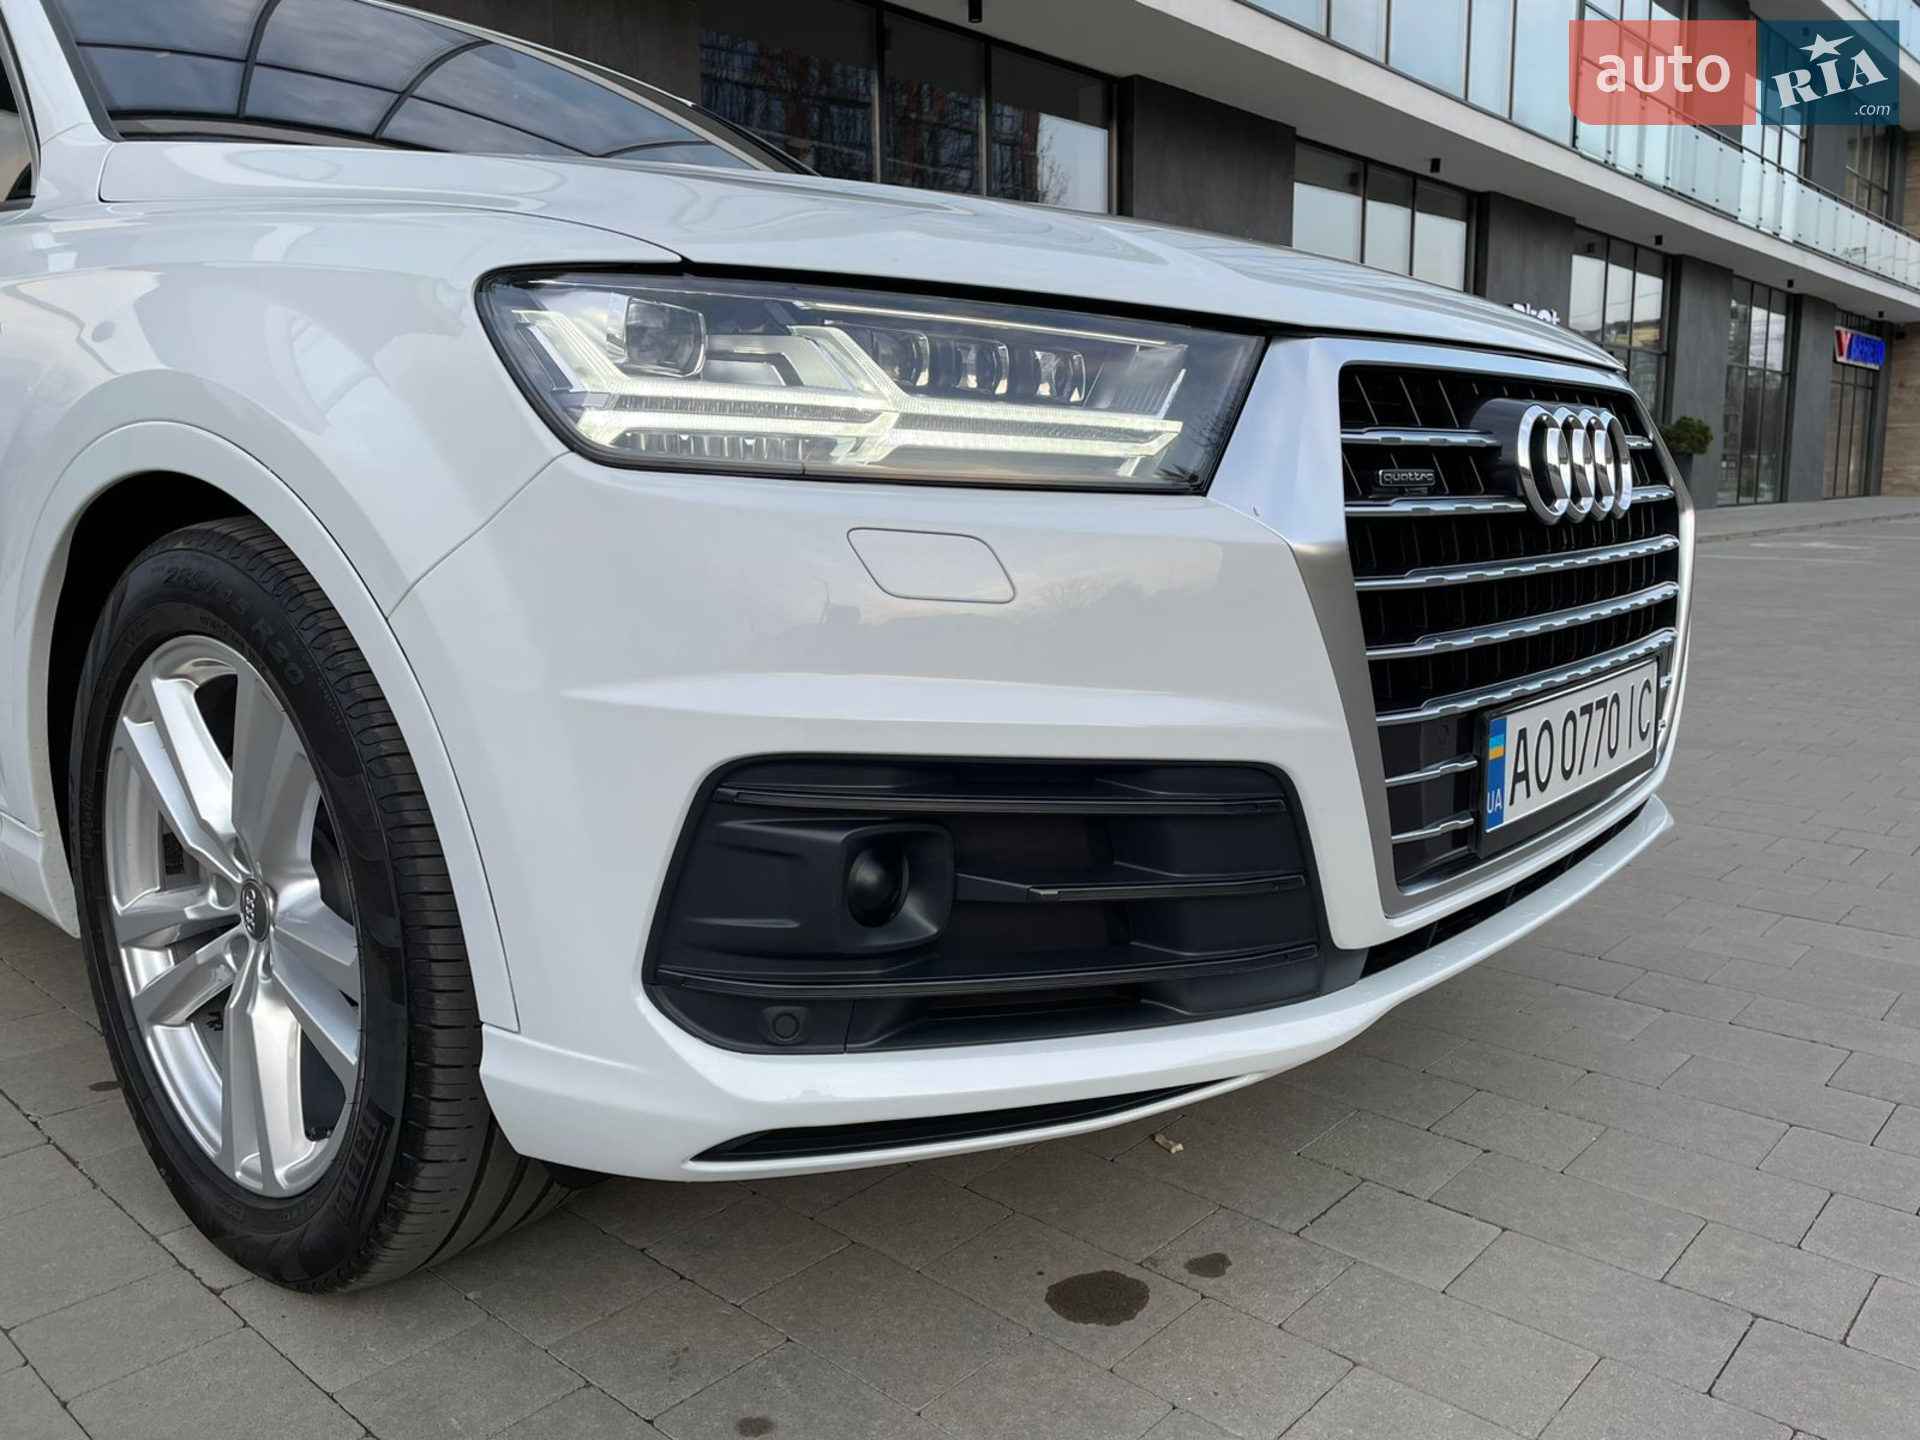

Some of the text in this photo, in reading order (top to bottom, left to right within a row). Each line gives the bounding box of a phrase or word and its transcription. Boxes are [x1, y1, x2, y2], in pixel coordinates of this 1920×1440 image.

[1383, 472, 1434, 485] quattro
[1509, 677, 1652, 807] AO 0770 IC
[1486, 788, 1503, 814] UA
